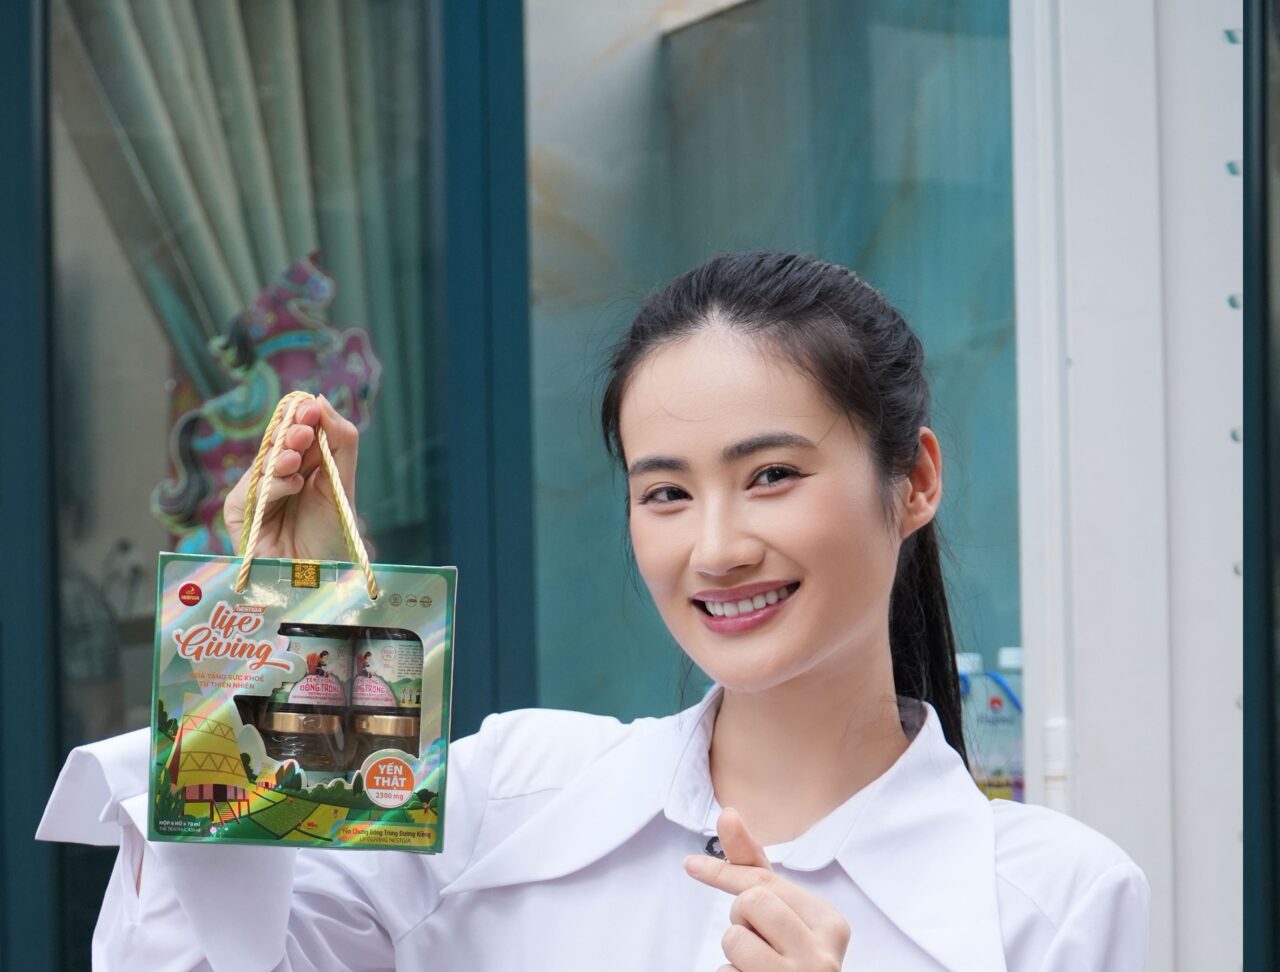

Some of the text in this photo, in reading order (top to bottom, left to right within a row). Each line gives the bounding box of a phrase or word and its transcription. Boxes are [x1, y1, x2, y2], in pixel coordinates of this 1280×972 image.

[210, 604, 262, 639] life
[175, 627, 290, 670] Giving
[378, 761, 403, 775] YẾN
[374, 775, 406, 790] THẬT
[393, 793, 404, 801] mg
